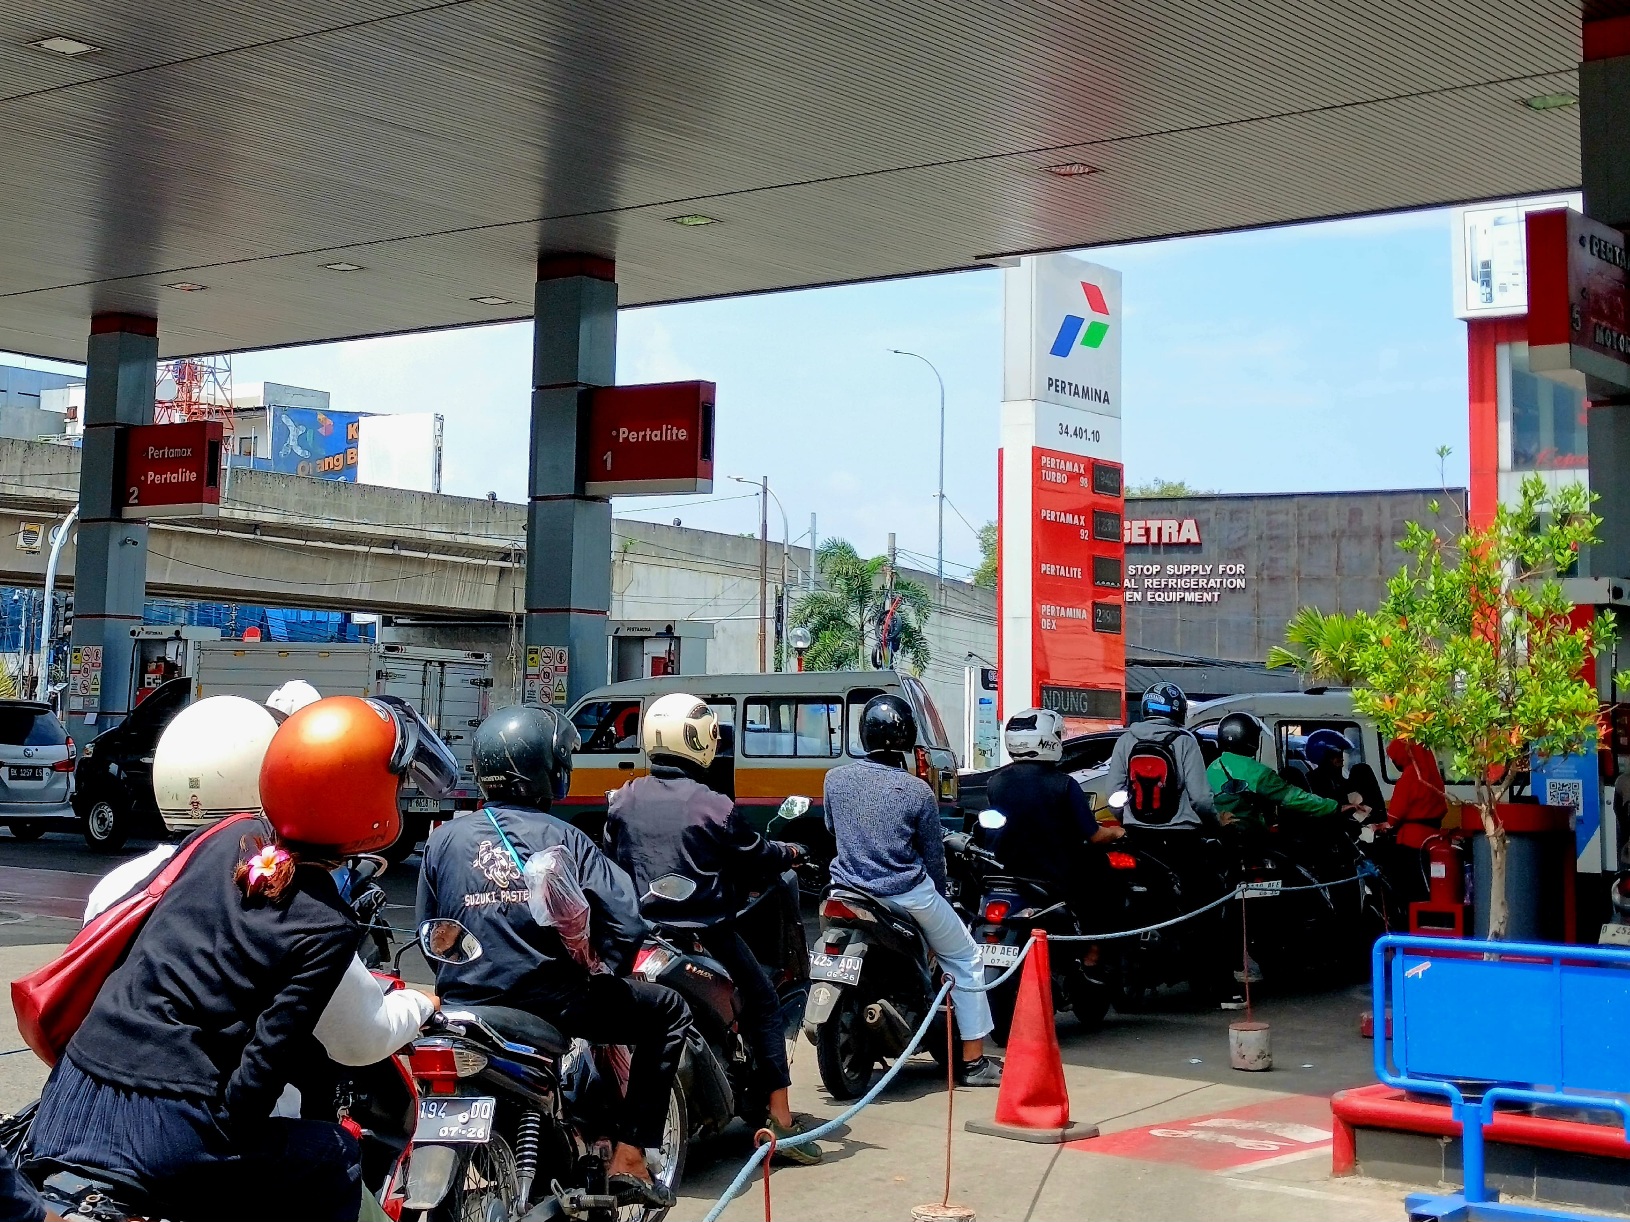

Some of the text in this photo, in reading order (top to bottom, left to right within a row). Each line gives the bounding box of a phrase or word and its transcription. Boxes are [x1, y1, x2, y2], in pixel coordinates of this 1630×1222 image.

[1047, 376, 1110, 405] PERTAMINA
[619, 424, 687, 443] Pertalite
[1058, 422, 1100, 443] 34.401.10
[148, 446, 192, 459] Pertamax
[603, 450, 612, 470] 1
[1041, 455, 1085, 475] PERTAMAX
[147, 468, 197, 485] Pertalite
[1042, 470, 1068, 484] TURBO
[128, 486, 139, 504] 2
[1041, 508, 1086, 527] PERTAMAX
[1079, 528, 1089, 541] 92
[1041, 563, 1082, 579] PERTALITE
[1128, 563, 1246, 576] STOP SUPPLY FOR
[1144, 578, 1247, 590] REFRIGERATION
[1147, 591, 1221, 603] EQUIPMENT
[1041, 604, 1087, 620] PERTAMINA
[1041, 618, 1057, 630] DEX
[464, 891, 497, 907] SUZUKI
[839, 957, 860, 971] ADJ
